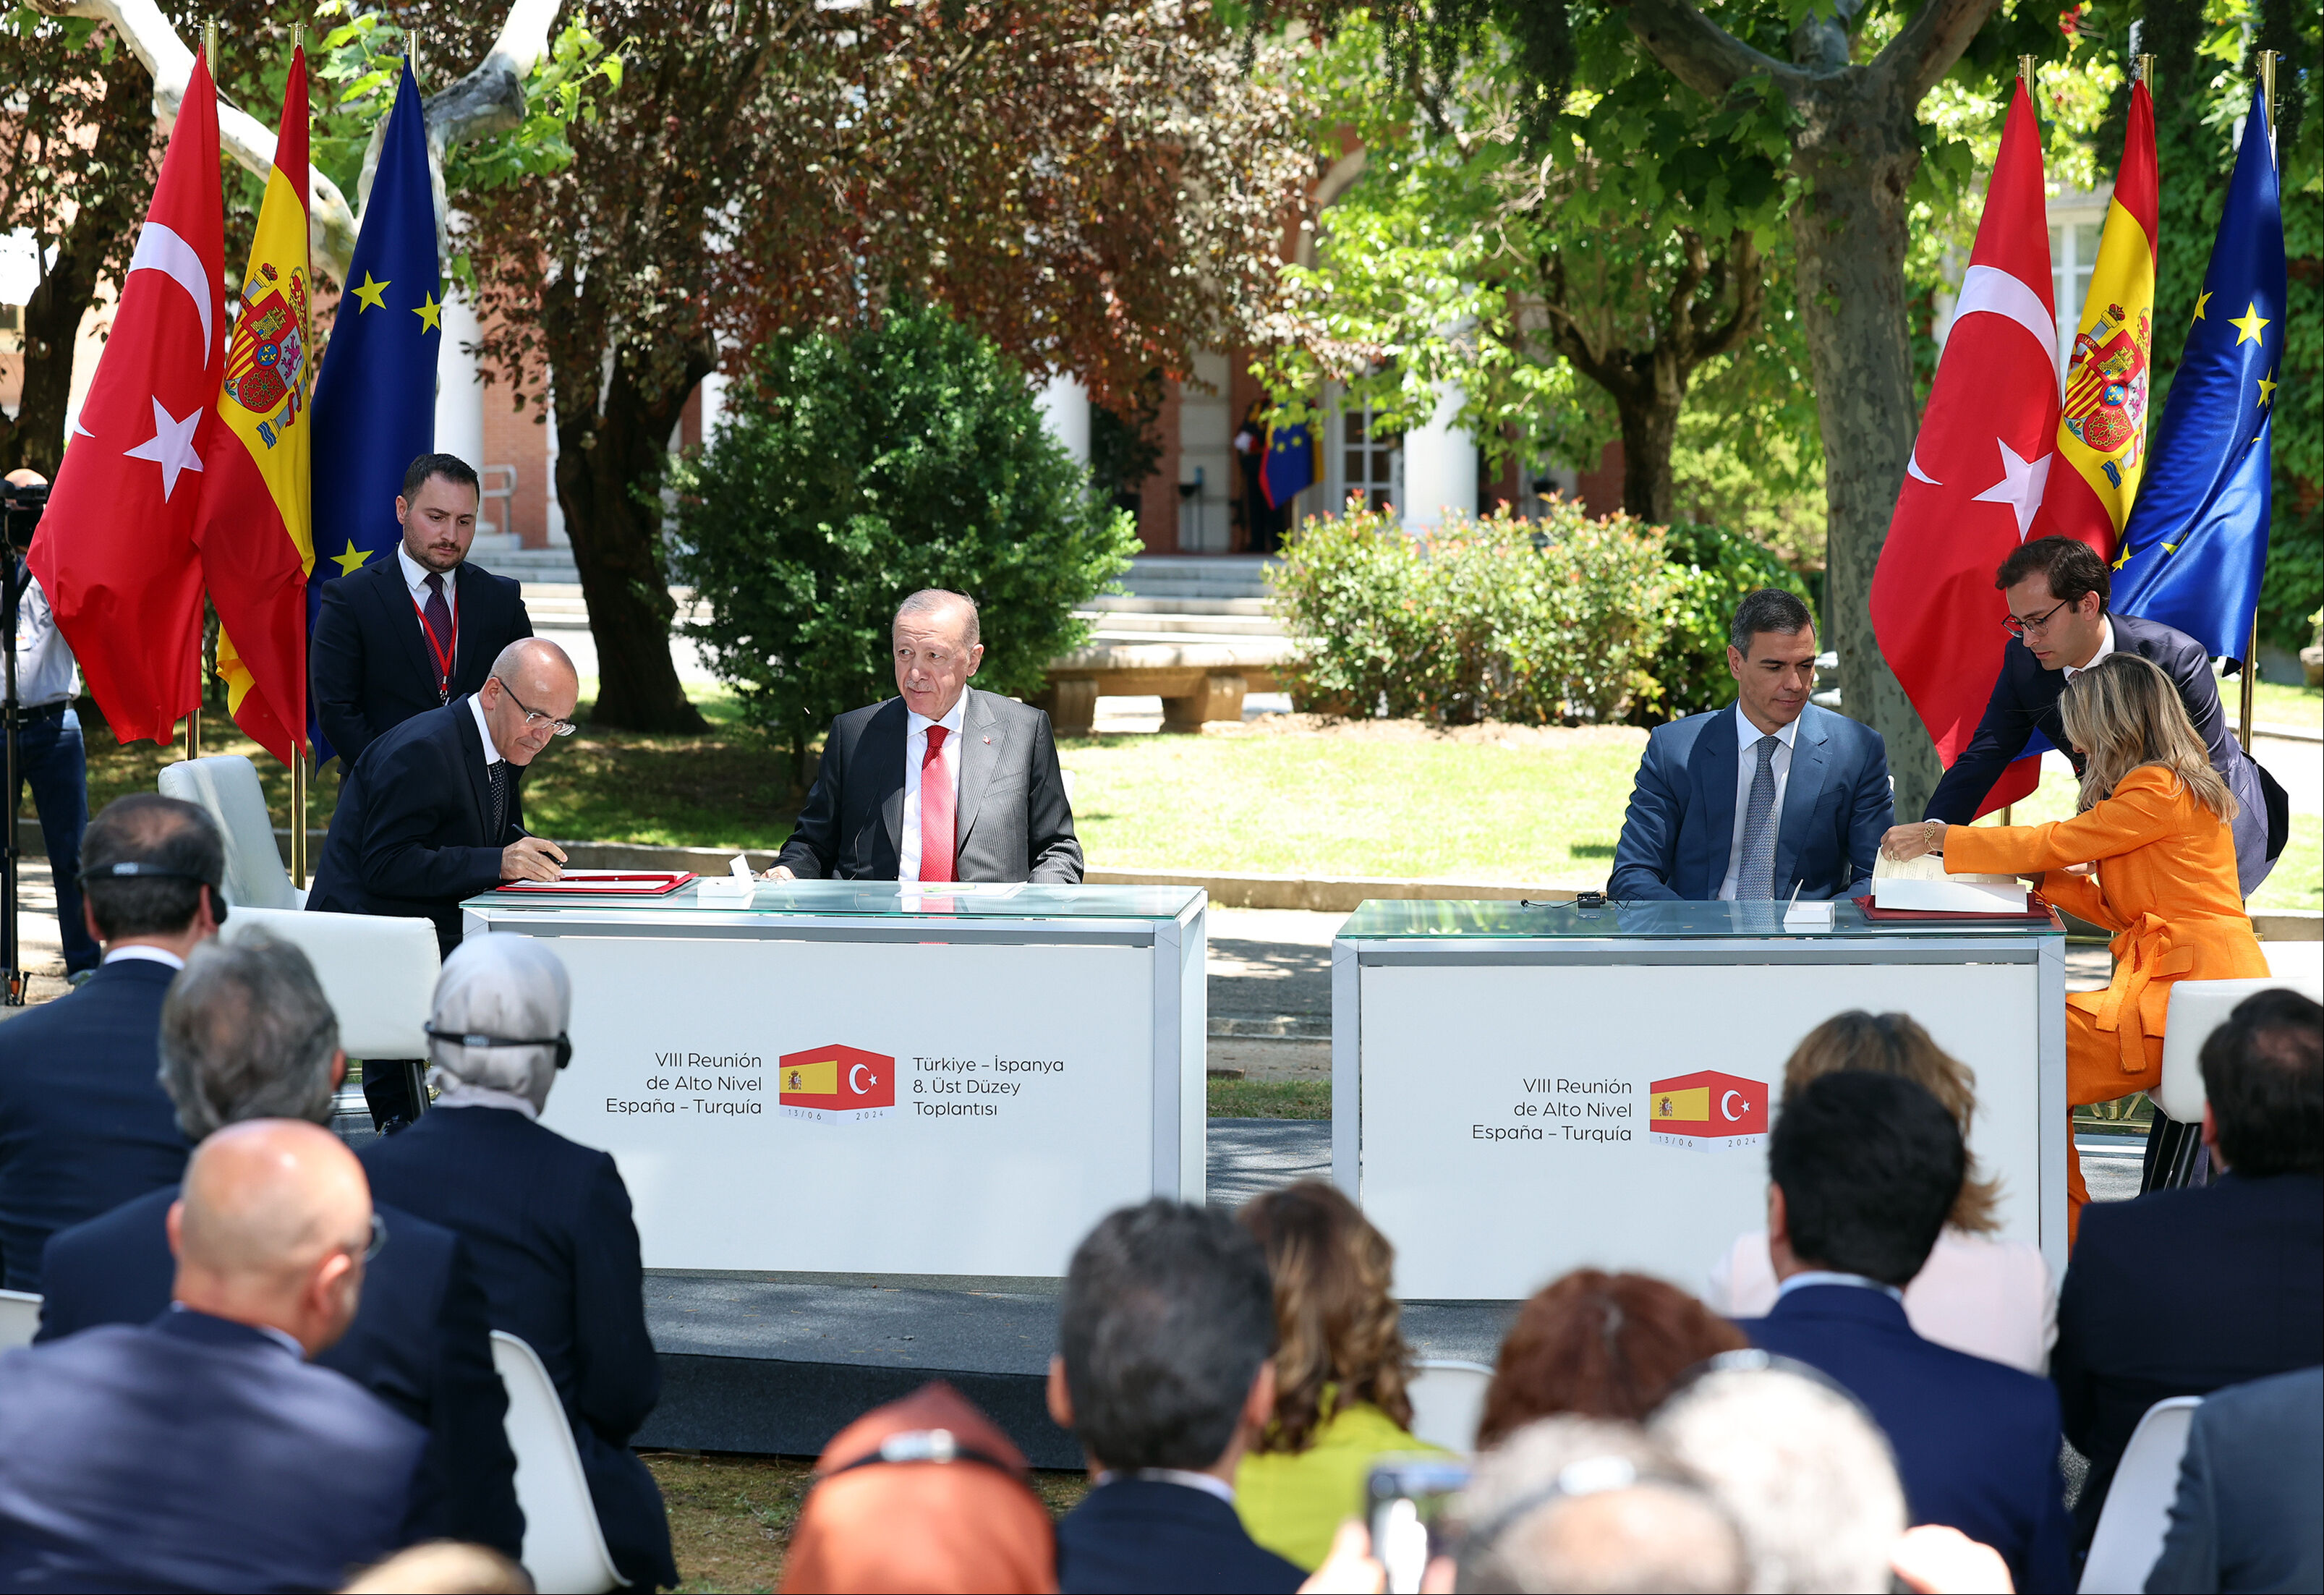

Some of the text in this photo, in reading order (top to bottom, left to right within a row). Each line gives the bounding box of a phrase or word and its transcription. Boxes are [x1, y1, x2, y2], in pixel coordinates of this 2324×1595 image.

[655, 1052, 762, 1068] VIII Reunión
[912, 1056, 977, 1075] Türkiye
[995, 1054, 1065, 1075] İspanya
[646, 1075, 762, 1092] de Alto Nivel
[913, 1076, 1021, 1097] 8. Üst Düzey
[1523, 1078, 1632, 1094] VIII Reunión
[606, 1097, 675, 1117] España
[692, 1098, 762, 1117] Turquía
[788, 1108, 822, 1120] 13/06
[856, 1110, 884, 1120] 2024
[912, 1101, 997, 1118] Toplantısı
[1514, 1101, 1632, 1118] de Alto Nivel
[1473, 1124, 1543, 1143] España
[1561, 1125, 1632, 1144] Turquía
[1659, 1135, 1693, 1148] 13/06
[1728, 1137, 1757, 1148] 2024
